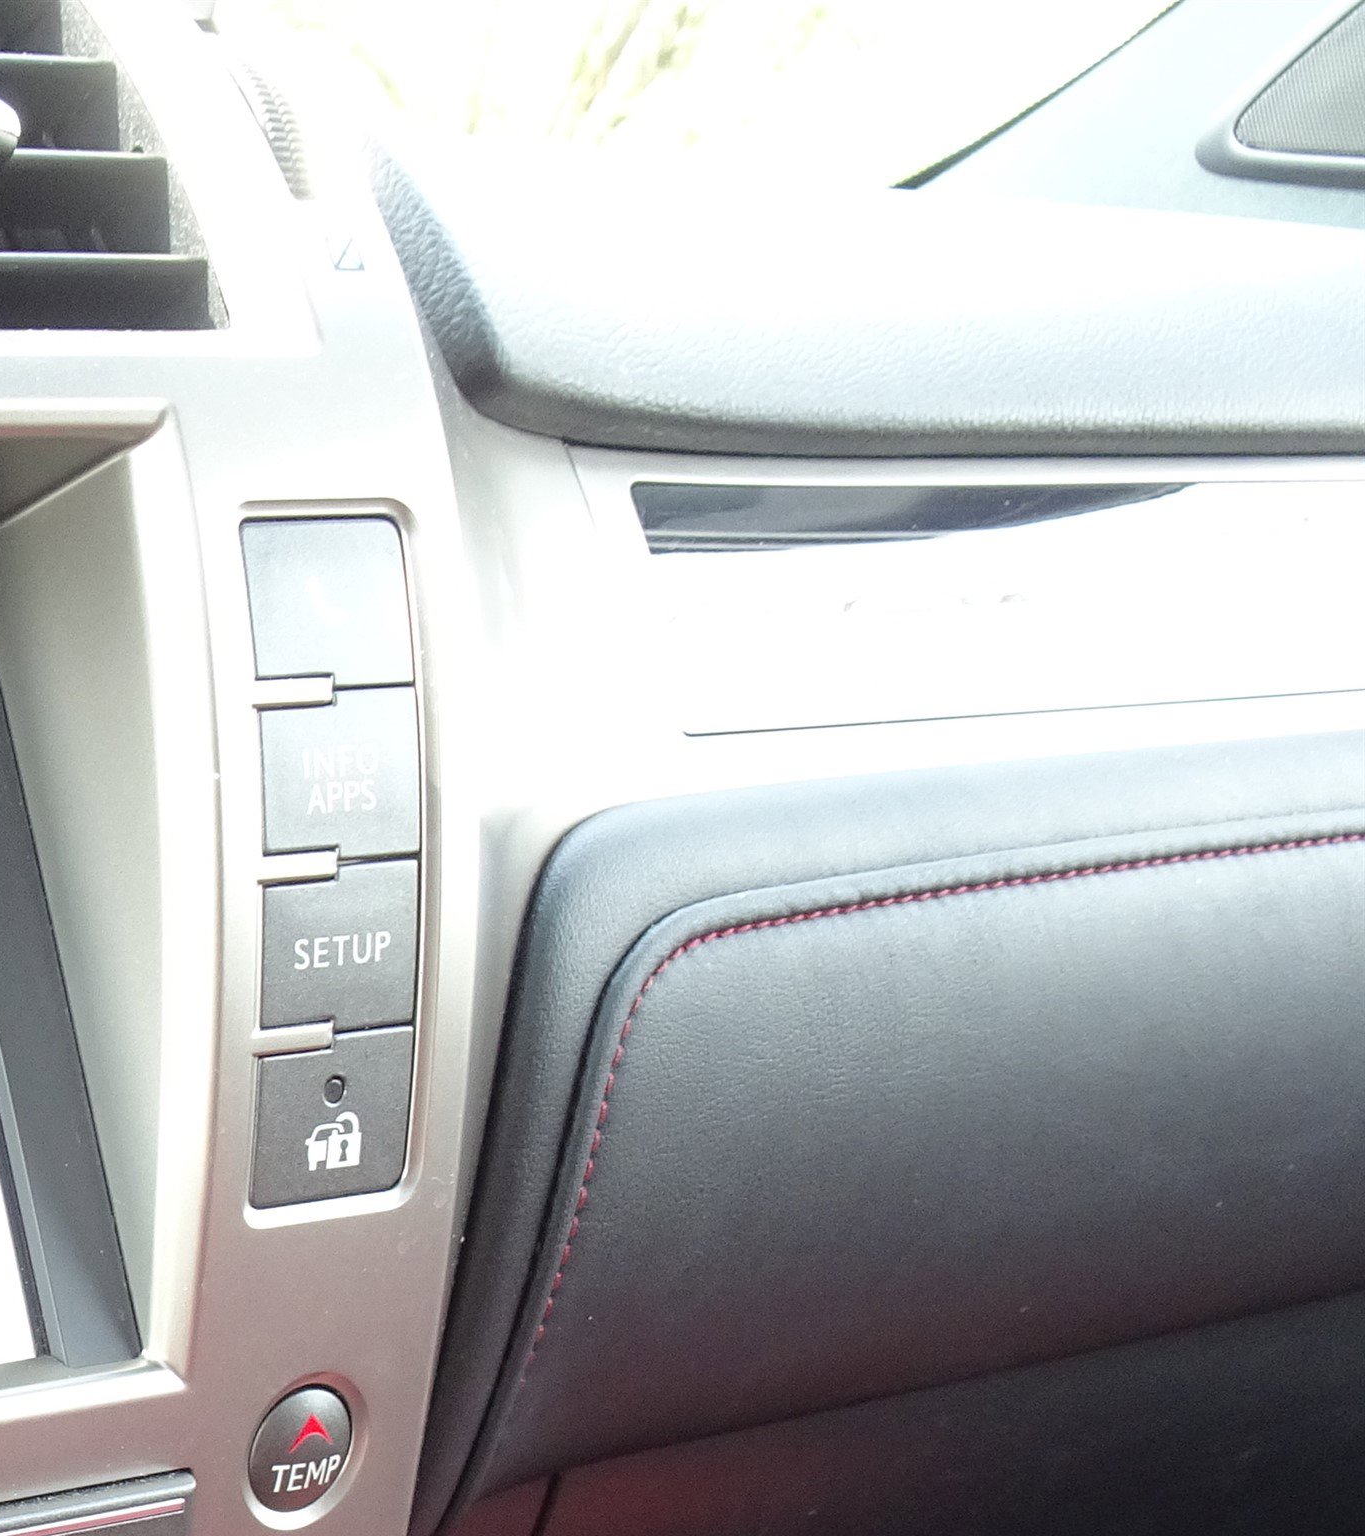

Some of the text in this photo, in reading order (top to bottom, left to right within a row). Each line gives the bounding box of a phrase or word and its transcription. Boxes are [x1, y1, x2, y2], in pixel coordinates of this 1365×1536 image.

[306, 779, 376, 815] APPS
[294, 931, 392, 970] SETUP
[270, 1453, 341, 1494] TEMP
